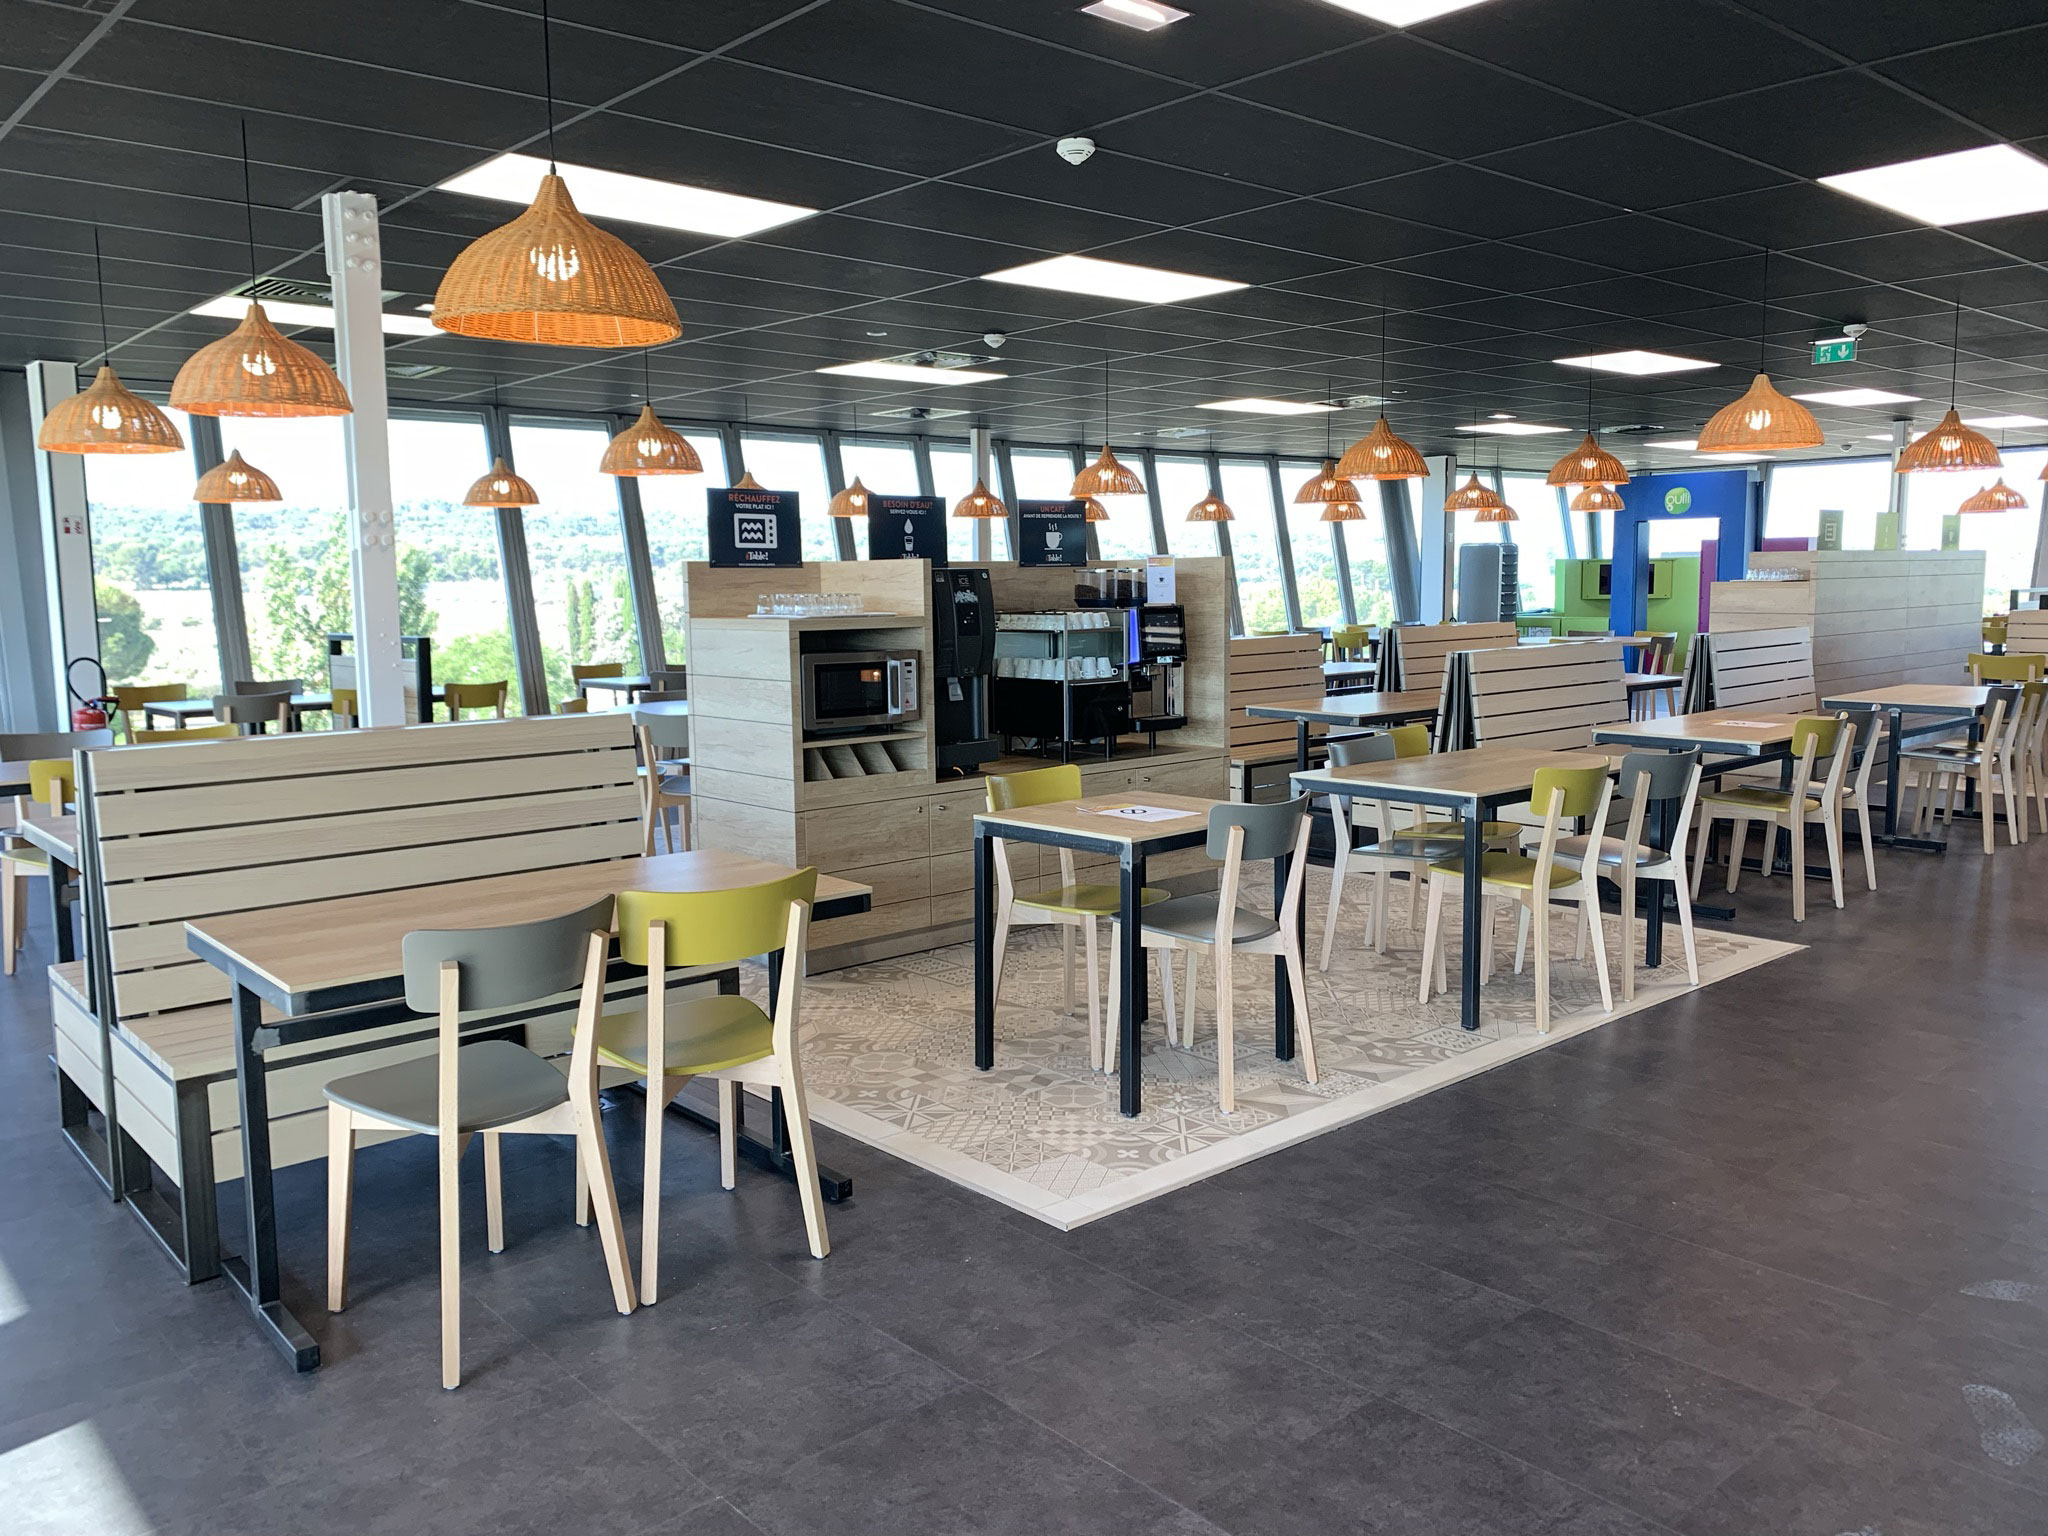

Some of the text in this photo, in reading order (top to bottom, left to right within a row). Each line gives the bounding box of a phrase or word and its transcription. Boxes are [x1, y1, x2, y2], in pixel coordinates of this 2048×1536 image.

[728, 493, 780, 503] RÉCHAUFFEZ
[1666, 492, 1690, 511] gulli
[883, 500, 909, 508] BESOIN
[958, 577, 970, 585] ICE
